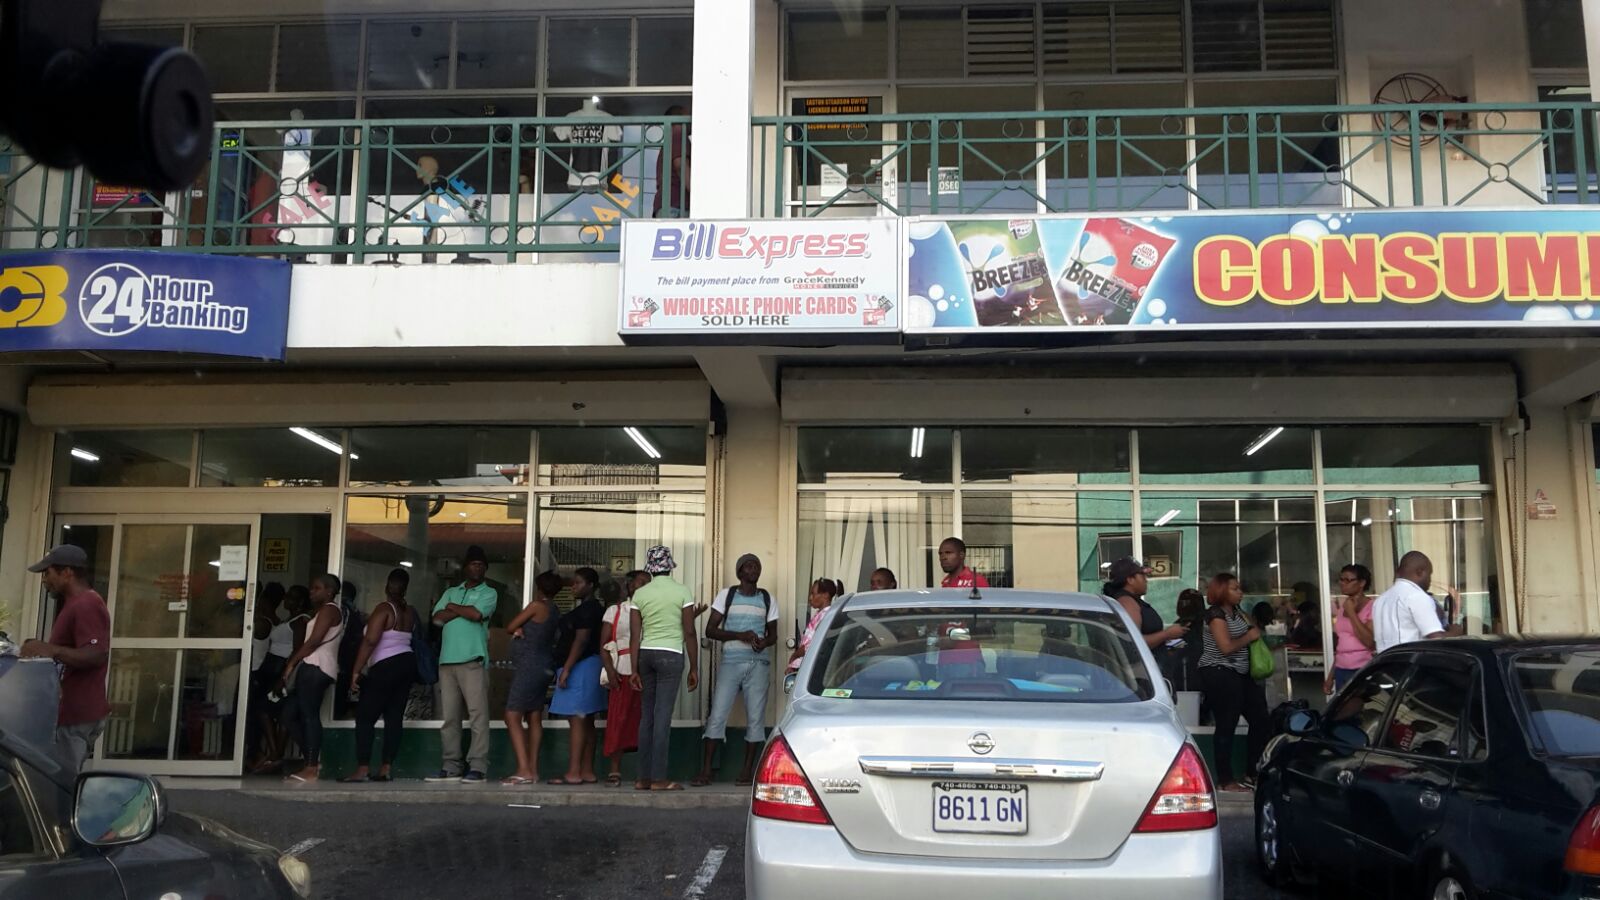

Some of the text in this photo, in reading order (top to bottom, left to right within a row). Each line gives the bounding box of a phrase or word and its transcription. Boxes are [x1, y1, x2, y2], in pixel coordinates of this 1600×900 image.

[937, 180, 959, 191] OSED
[652, 223, 869, 268] Bill Express
[657, 276, 780, 288] The bill payment place from
[784, 276, 866, 285] GraceKennedy
[972, 258, 1042, 292] BREEZE
[1065, 261, 1134, 308] BREEZE
[88, 275, 213, 324] 24 Hour
[663, 297, 750, 316] WHOLESALE
[753, 297, 802, 315] PHONE
[806, 296, 857, 315] CARDS
[148, 301, 248, 333] Banking
[701, 315, 790, 326] SOLD HERE
[615, 560, 624, 571] 2
[1155, 560, 1166, 573] 5
[939, 795, 1022, 822] 8611 GN
